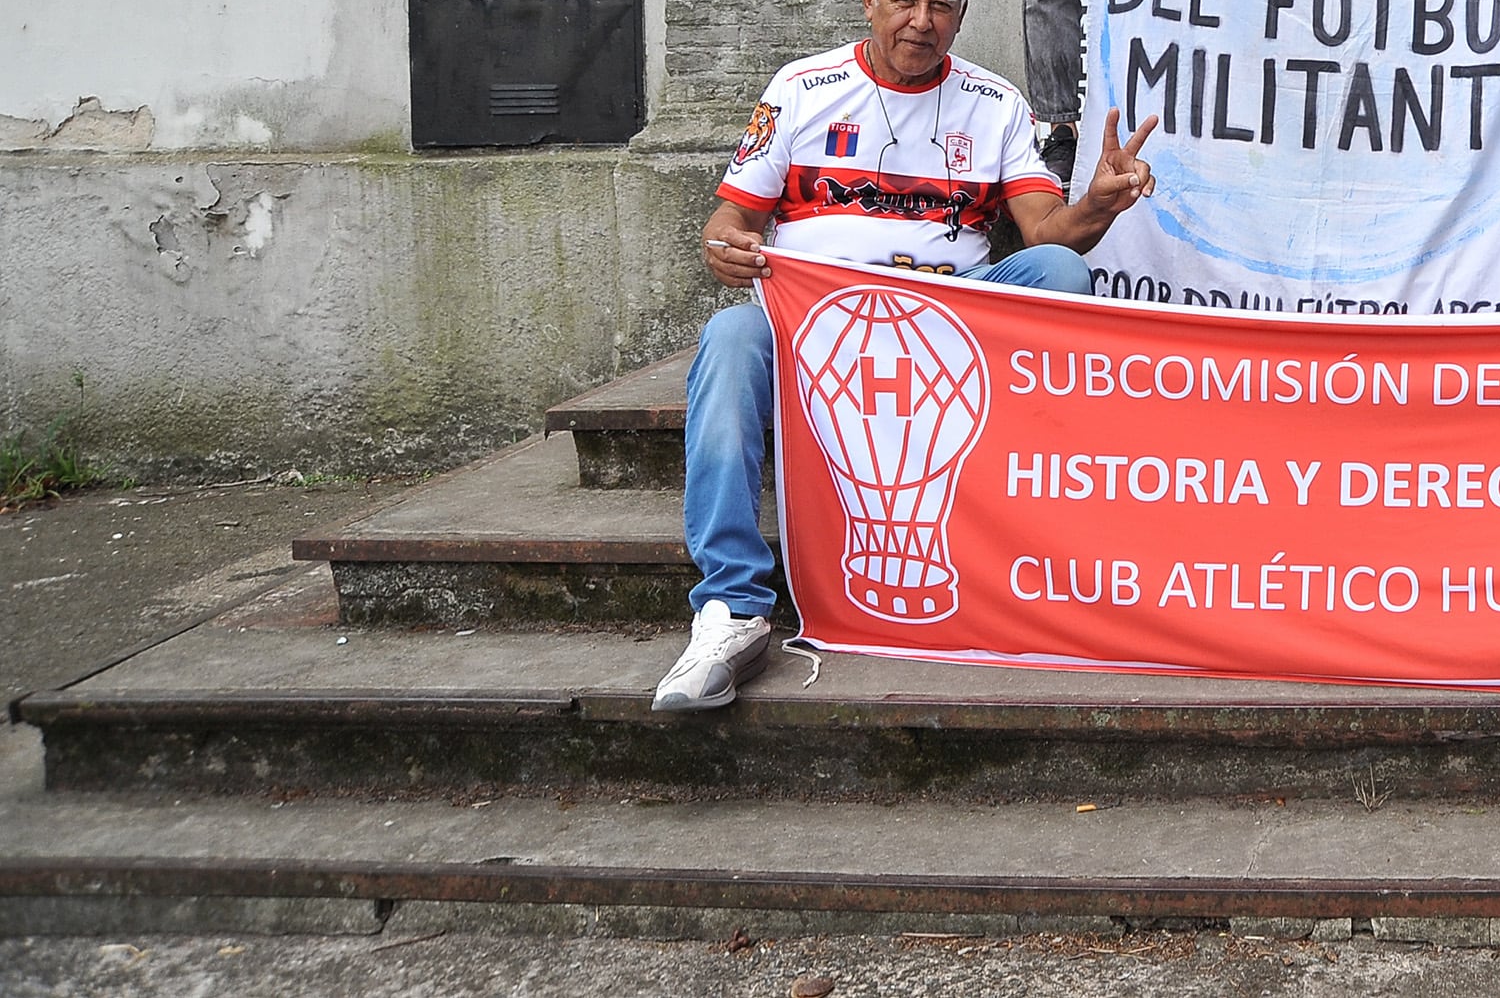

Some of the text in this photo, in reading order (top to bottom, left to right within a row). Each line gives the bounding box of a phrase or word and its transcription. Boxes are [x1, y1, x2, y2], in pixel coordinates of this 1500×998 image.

[831, 123, 859, 133] TIGRE
[1008, 349, 1409, 406] SUBCOMISIÓN
[1007, 451, 1269, 506] HISTORIA
[1285, 461, 1322, 506] Y
[1008, 555, 1142, 608] CLUB
[1157, 551, 1420, 613] ATLÉTICO
